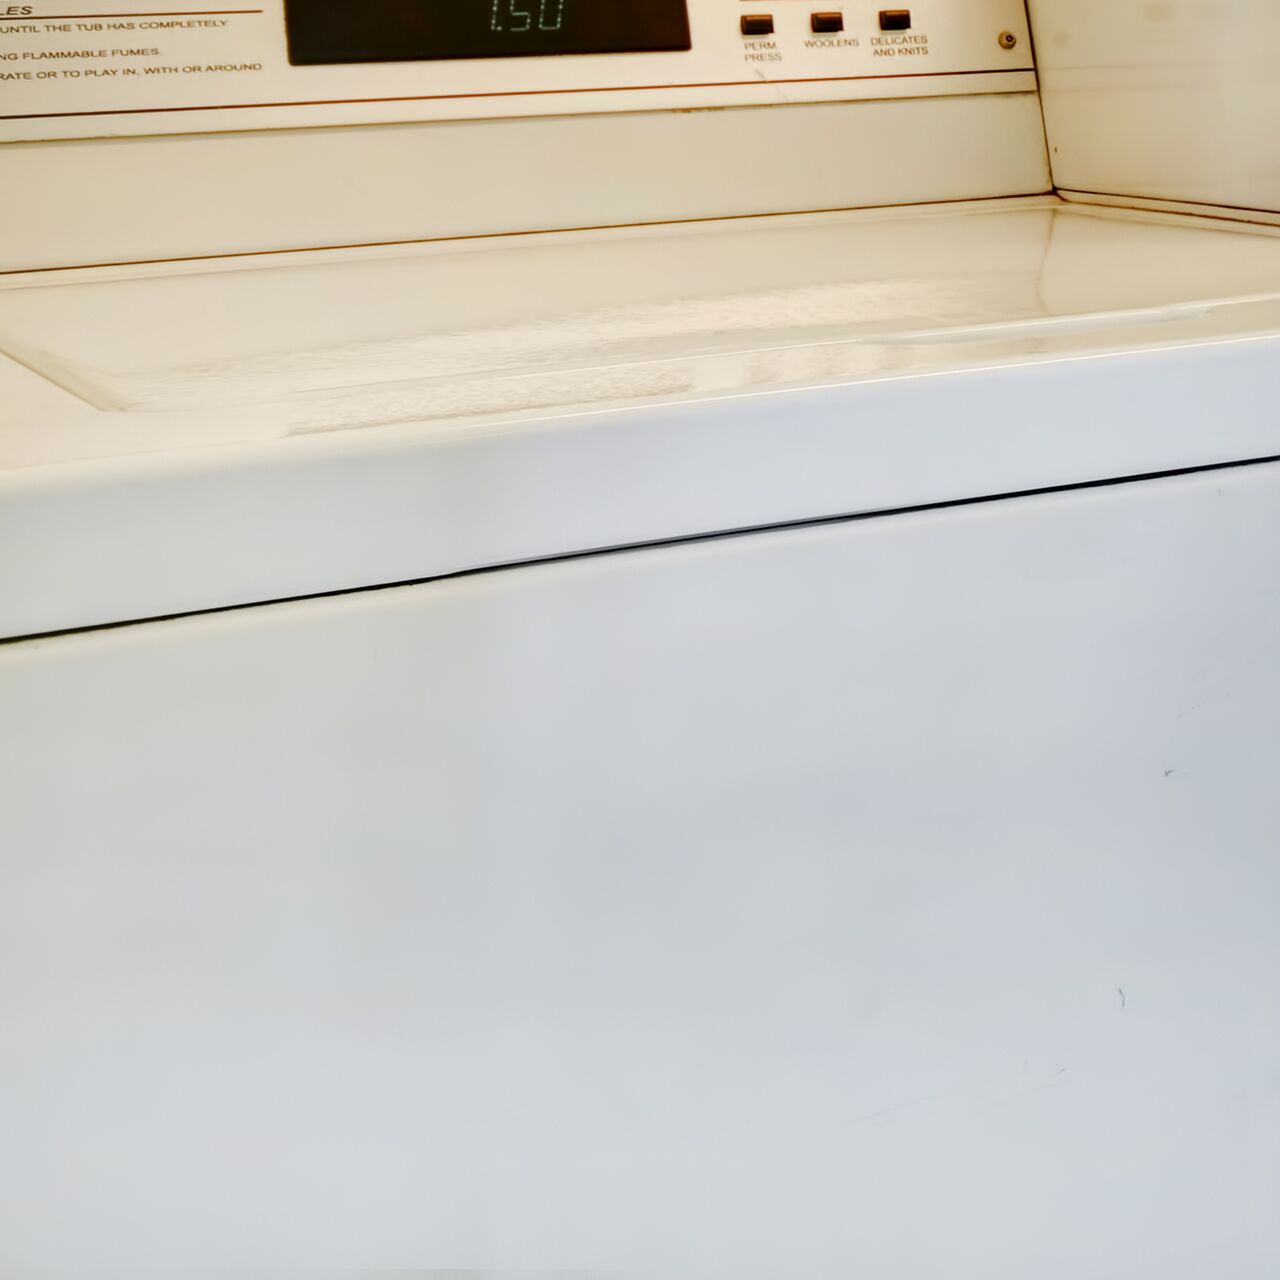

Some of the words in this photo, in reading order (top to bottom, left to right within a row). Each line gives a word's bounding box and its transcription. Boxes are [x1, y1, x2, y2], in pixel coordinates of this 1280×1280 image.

[0, 25, 40, 34] UNTIL
[44, 24, 71, 33] THE
[76, 23, 103, 31] TUB
[107, 22, 136, 30] HAS
[139, 20, 228, 29] COMPLETELY
[803, 38, 860, 48] WOOLENS
[870, 35, 928, 46] DELICATES
[22, 50, 107, 60] FLAMMABLE
[873, 48, 896, 57] AND
[897, 46, 929, 56] KNITS
[744, 53, 783, 62] PRESS
[36, 71, 57, 79] OR
[61, 70, 81, 78] TO
[84, 69, 118, 77] PLAY
[143, 66, 178, 75] WITH
[182, 65, 201, 73] OR
[205, 63, 262, 72] AROUND
